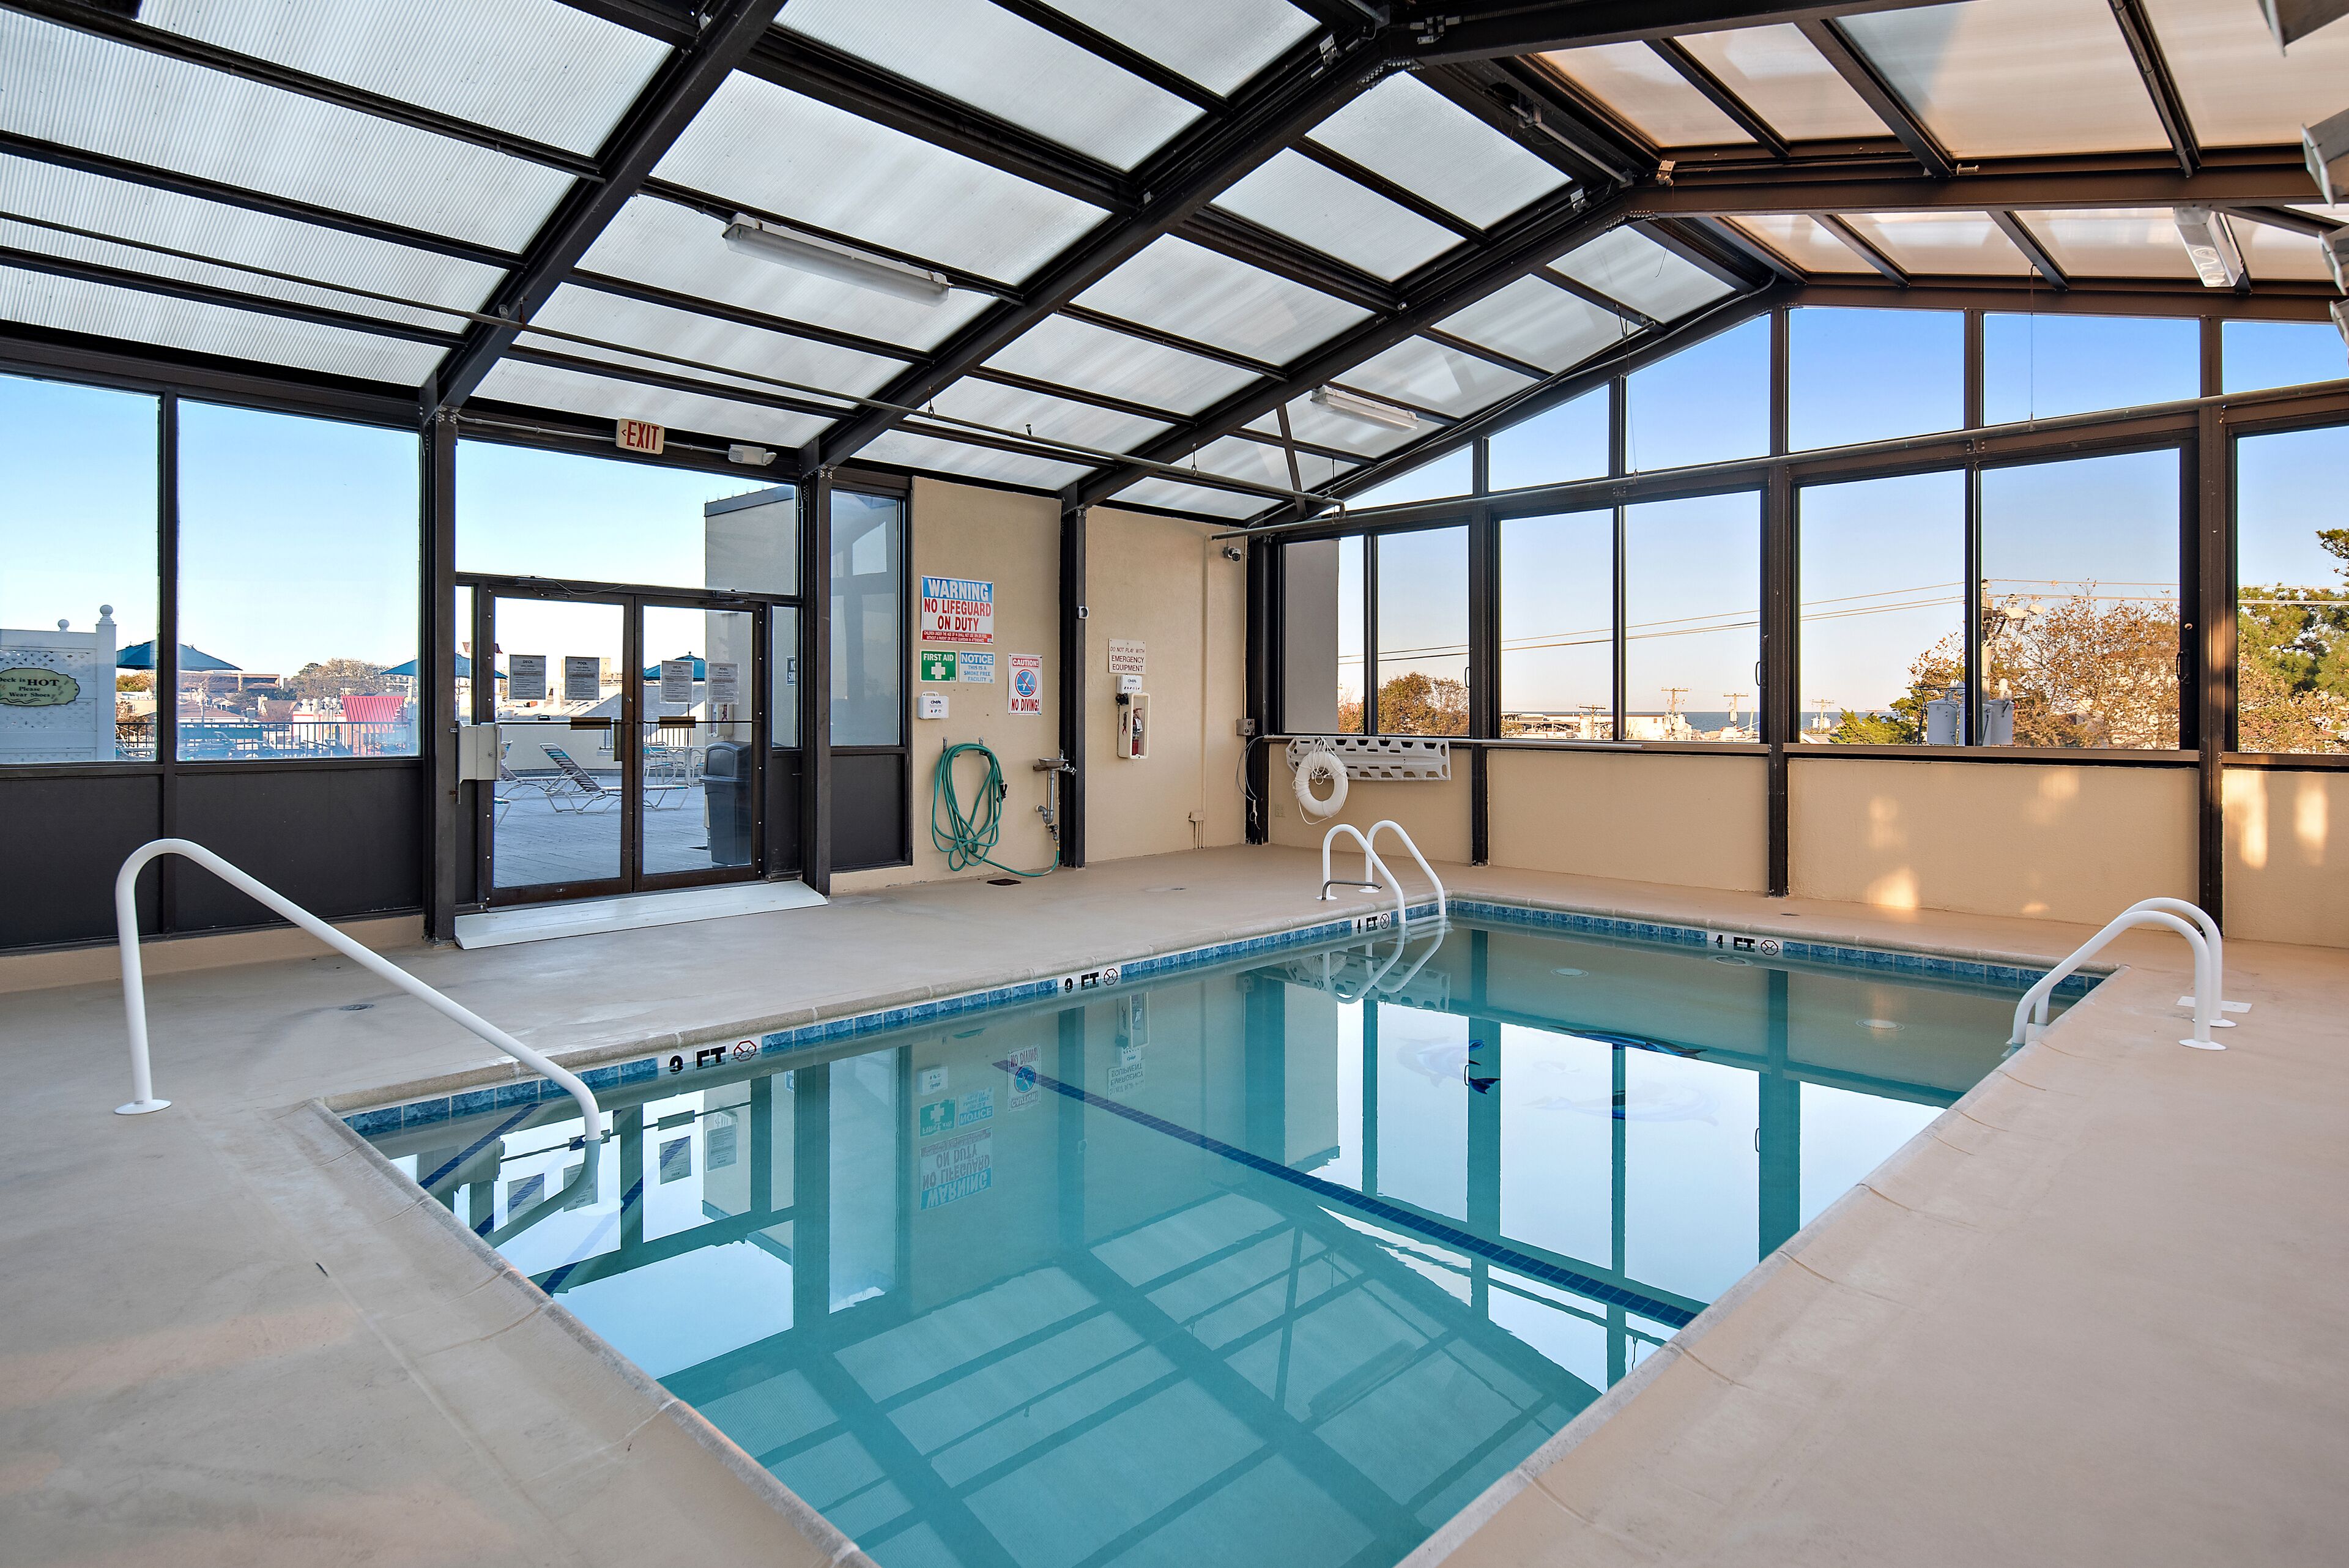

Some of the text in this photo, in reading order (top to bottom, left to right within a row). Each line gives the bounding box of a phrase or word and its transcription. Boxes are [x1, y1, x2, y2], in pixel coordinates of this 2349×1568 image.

[626, 421, 659, 450] EXIT
[927, 579, 989, 601] WARNING
[924, 598, 992, 617] NO LIFEGUARD
[937, 615, 979, 632] ON DUTY
[961, 654, 993, 664] NOTICE
[1011, 699, 1039, 712] NO DIVING!
